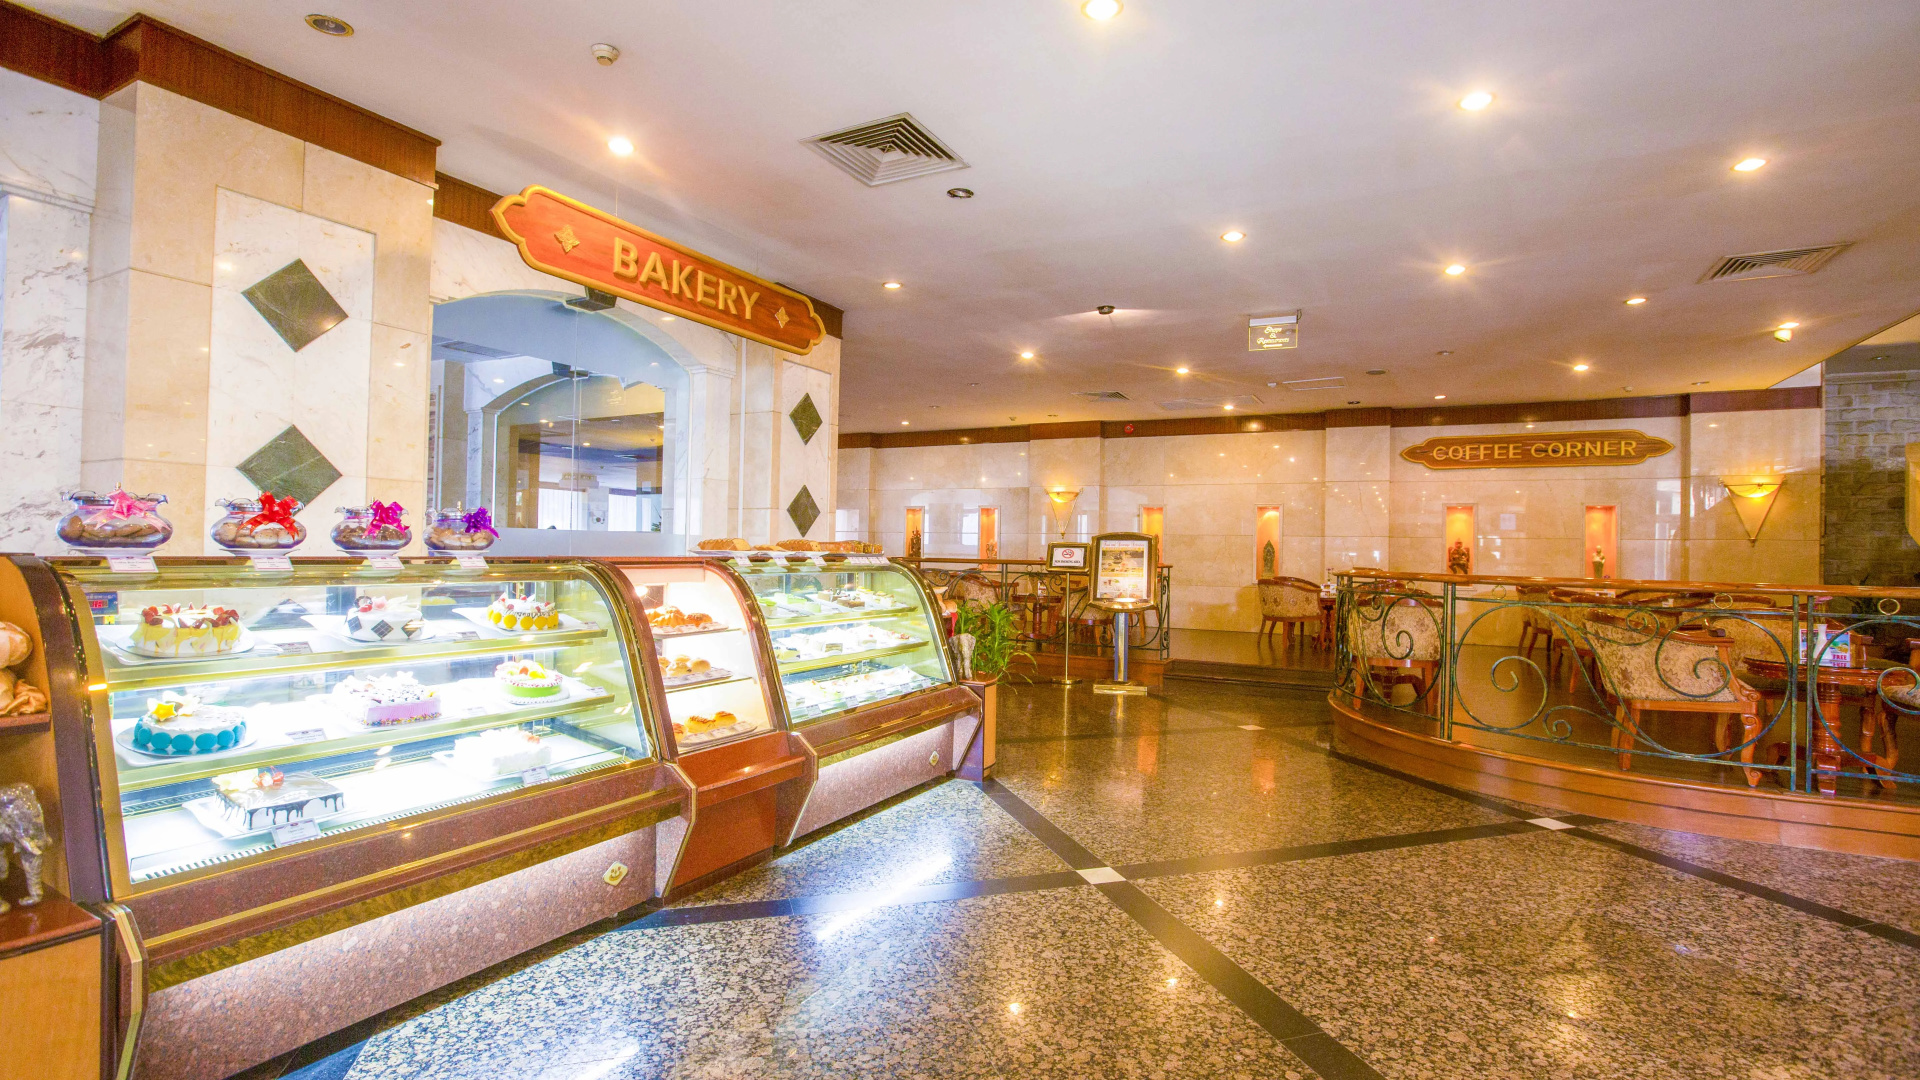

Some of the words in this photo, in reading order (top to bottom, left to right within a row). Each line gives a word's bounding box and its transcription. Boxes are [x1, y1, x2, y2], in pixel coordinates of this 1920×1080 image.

[613, 237, 760, 320] BAKERY
[1432, 443, 1522, 461] COFFEE
[1531, 440, 1637, 458] CORNER
